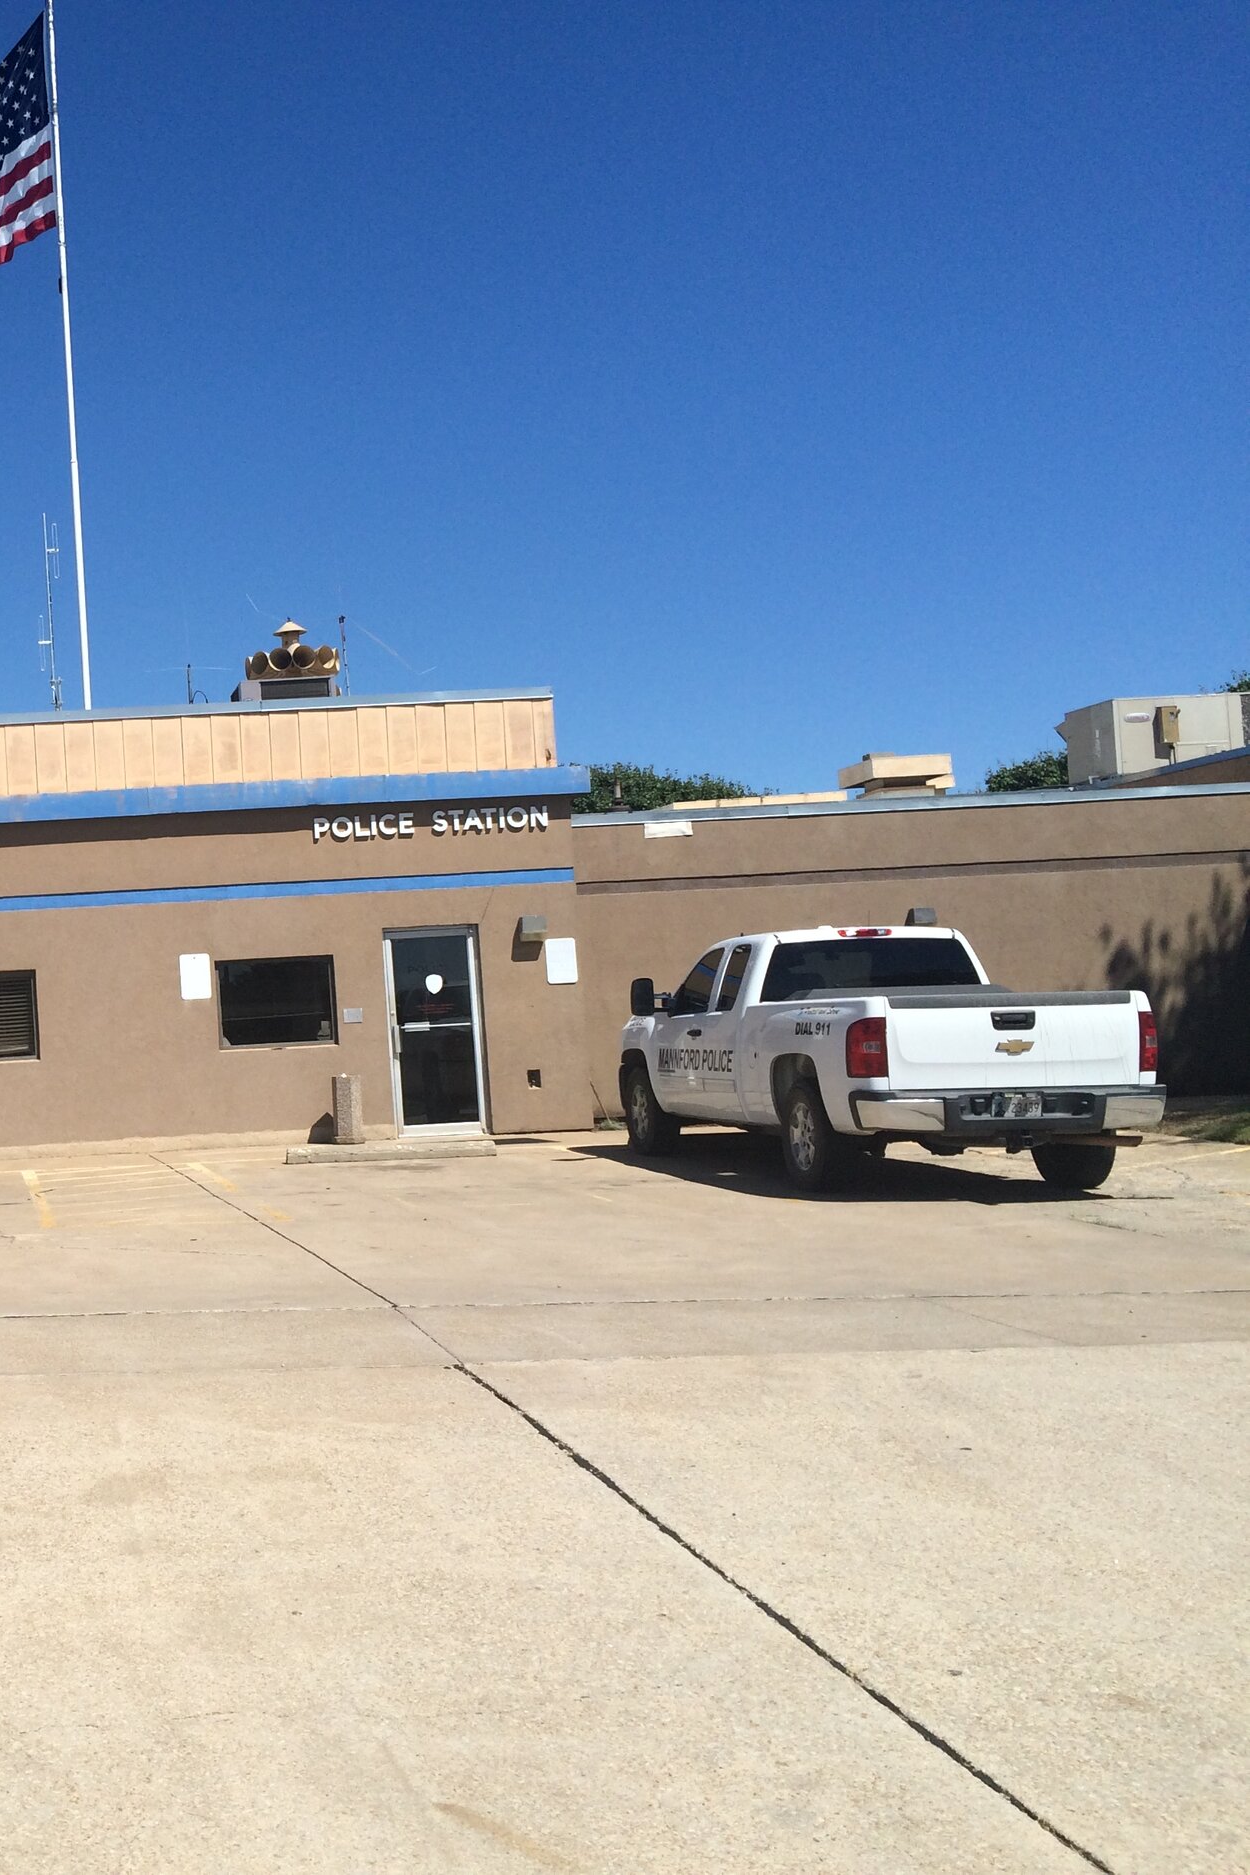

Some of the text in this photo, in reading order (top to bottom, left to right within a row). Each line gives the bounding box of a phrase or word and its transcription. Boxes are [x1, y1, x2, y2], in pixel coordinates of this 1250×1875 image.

[313, 805, 548, 839] POLICE STATION
[795, 1022, 831, 1036] DIAL 911
[658, 1048, 733, 1072] MANNFORD POLICE
